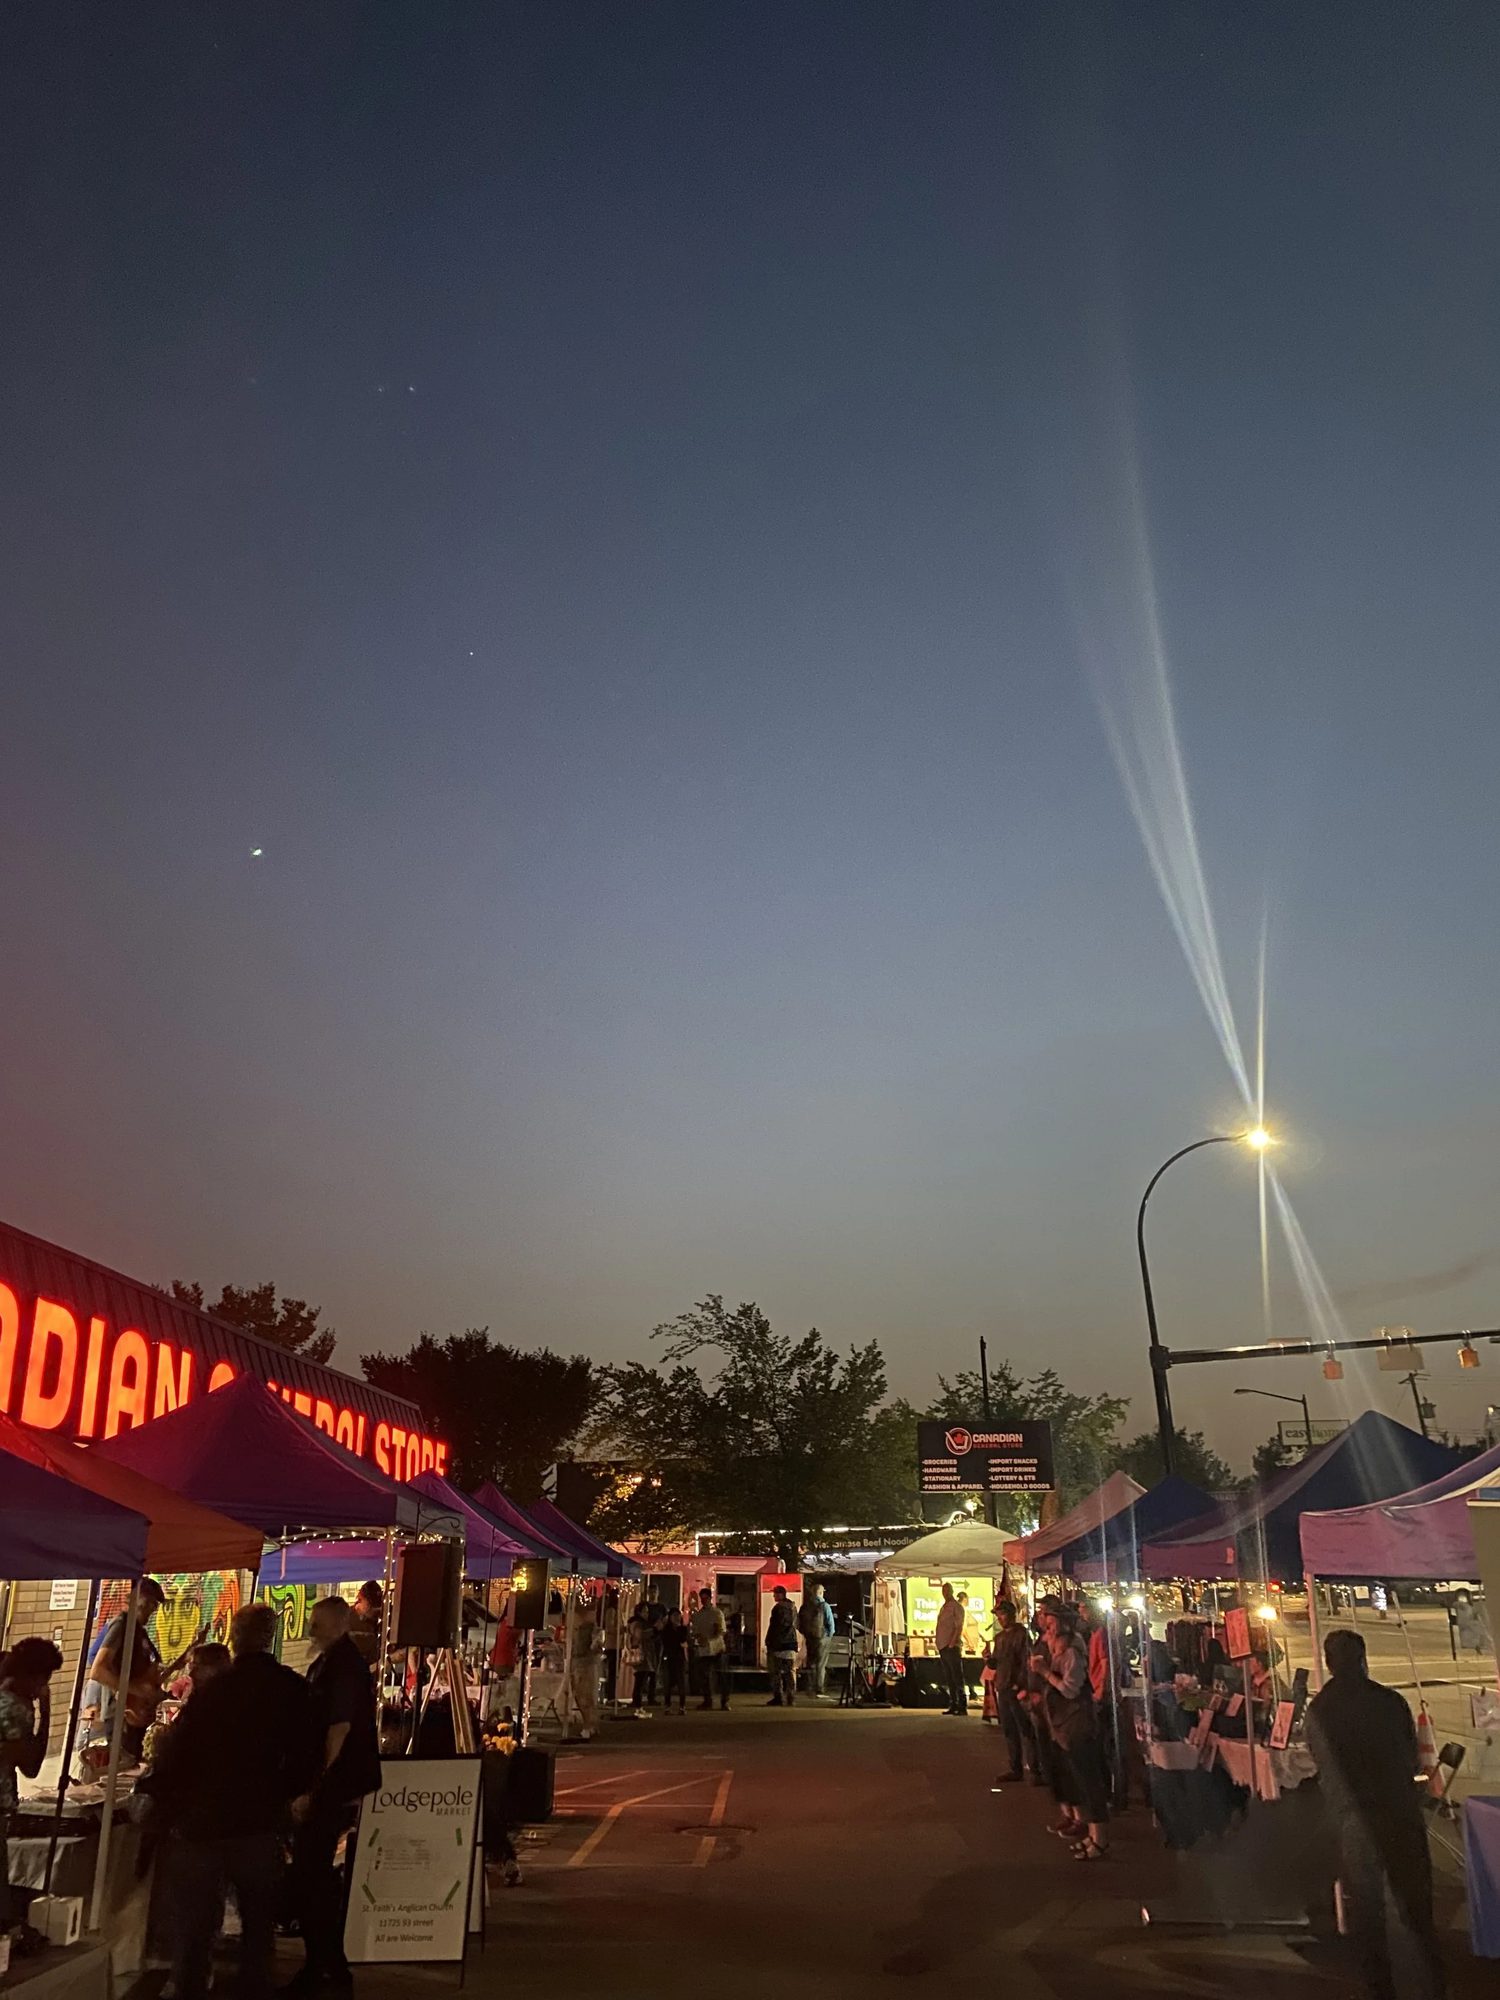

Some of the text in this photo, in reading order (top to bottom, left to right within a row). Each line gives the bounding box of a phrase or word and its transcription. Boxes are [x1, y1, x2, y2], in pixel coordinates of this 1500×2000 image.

[1285, 1424, 1340, 1441] eashom
[972, 1433, 1023, 1443] CANADIAN
[813, 1540, 861, 1549] Vieamese
[863, 1538, 881, 1547] Beef
[883, 1537, 913, 1546] Noodle
[372, 1785, 473, 1813] Lodgepole
[436, 1806, 471, 1816] MARKET
[373, 1904, 395, 1912] Faith's
[397, 1904, 427, 1913] Anglican
[375, 1934, 385, 1943] All
[399, 1934, 434, 1942] Welcome
